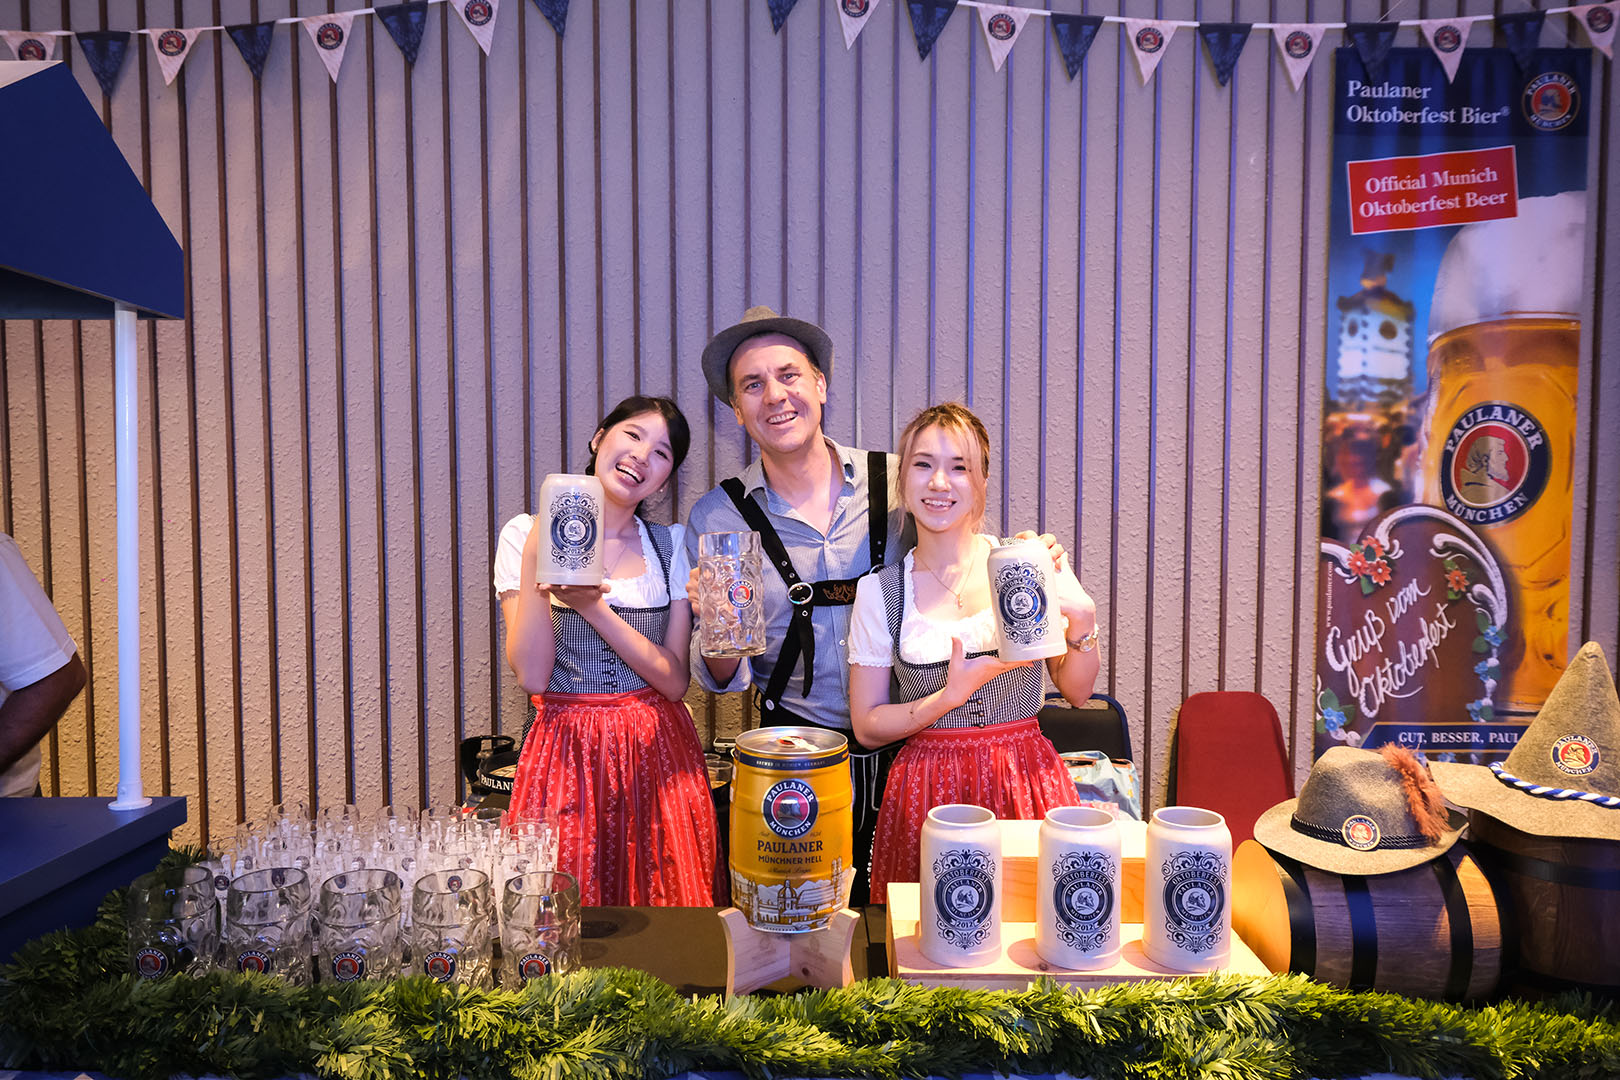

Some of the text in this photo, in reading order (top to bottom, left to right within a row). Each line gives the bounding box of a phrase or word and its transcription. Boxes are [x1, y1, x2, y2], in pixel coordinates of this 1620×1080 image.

[1347, 80, 1432, 99] Paulaner
[1527, 74, 1577, 95] PAULANER
[1346, 104, 1456, 124] Oktoberfest
[1365, 167, 1498, 194] Official Munich
[1359, 191, 1508, 218] Oktoberfest Beer
[1445, 406, 1544, 452] PAULANER
[1446, 492, 1529, 521] MÜNCHEN
[1325, 578, 1432, 698] Gruß vom
[1359, 602, 1456, 718] Oktoberfest
[1398, 731, 1427, 744] GUT,
[1431, 731, 1484, 744] BESSER,
[766, 782, 815, 802] PAULANER
[757, 840, 823, 853] PAULANER
[758, 855, 822, 864] MÜNCHNER HELL
[942, 868, 989, 883] OKTOBERFEST
[1061, 870, 1109, 886] OKTOBERFEST
[1172, 870, 1221, 886] OKTOBERFEST
[948, 879, 982, 894] PAULANER
[1067, 882, 1103, 896] PAULANER
[1177, 882, 1215, 897] PAULANER
[956, 921, 974, 929] 2012
[1075, 923, 1094, 931] 2012
[1186, 924, 1206, 932] 2012
